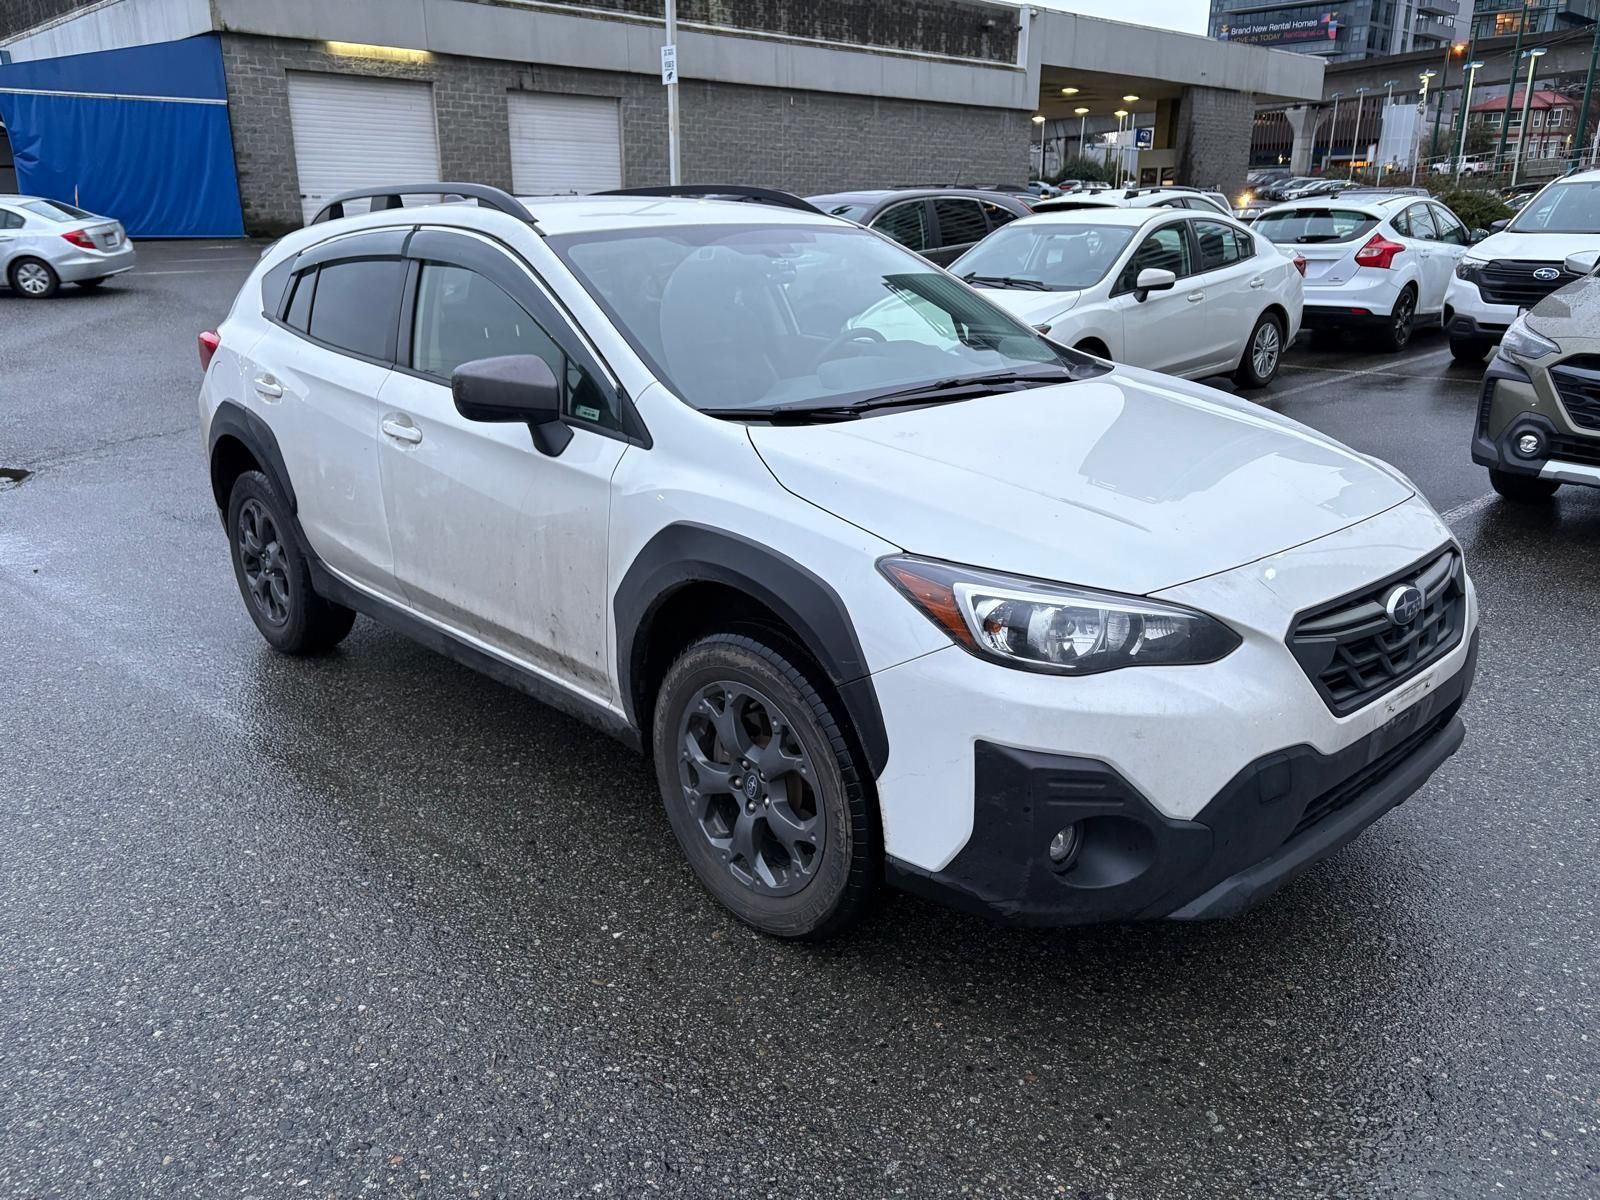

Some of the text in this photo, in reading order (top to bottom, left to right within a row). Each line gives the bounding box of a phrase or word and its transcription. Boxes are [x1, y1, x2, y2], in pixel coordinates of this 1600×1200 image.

[1231, 26, 1251, 35] Brand
[1269, 21, 1292, 31] Rental
[1292, 20, 1317, 29] Homes
[1260, 33, 1281, 41] TODAY
